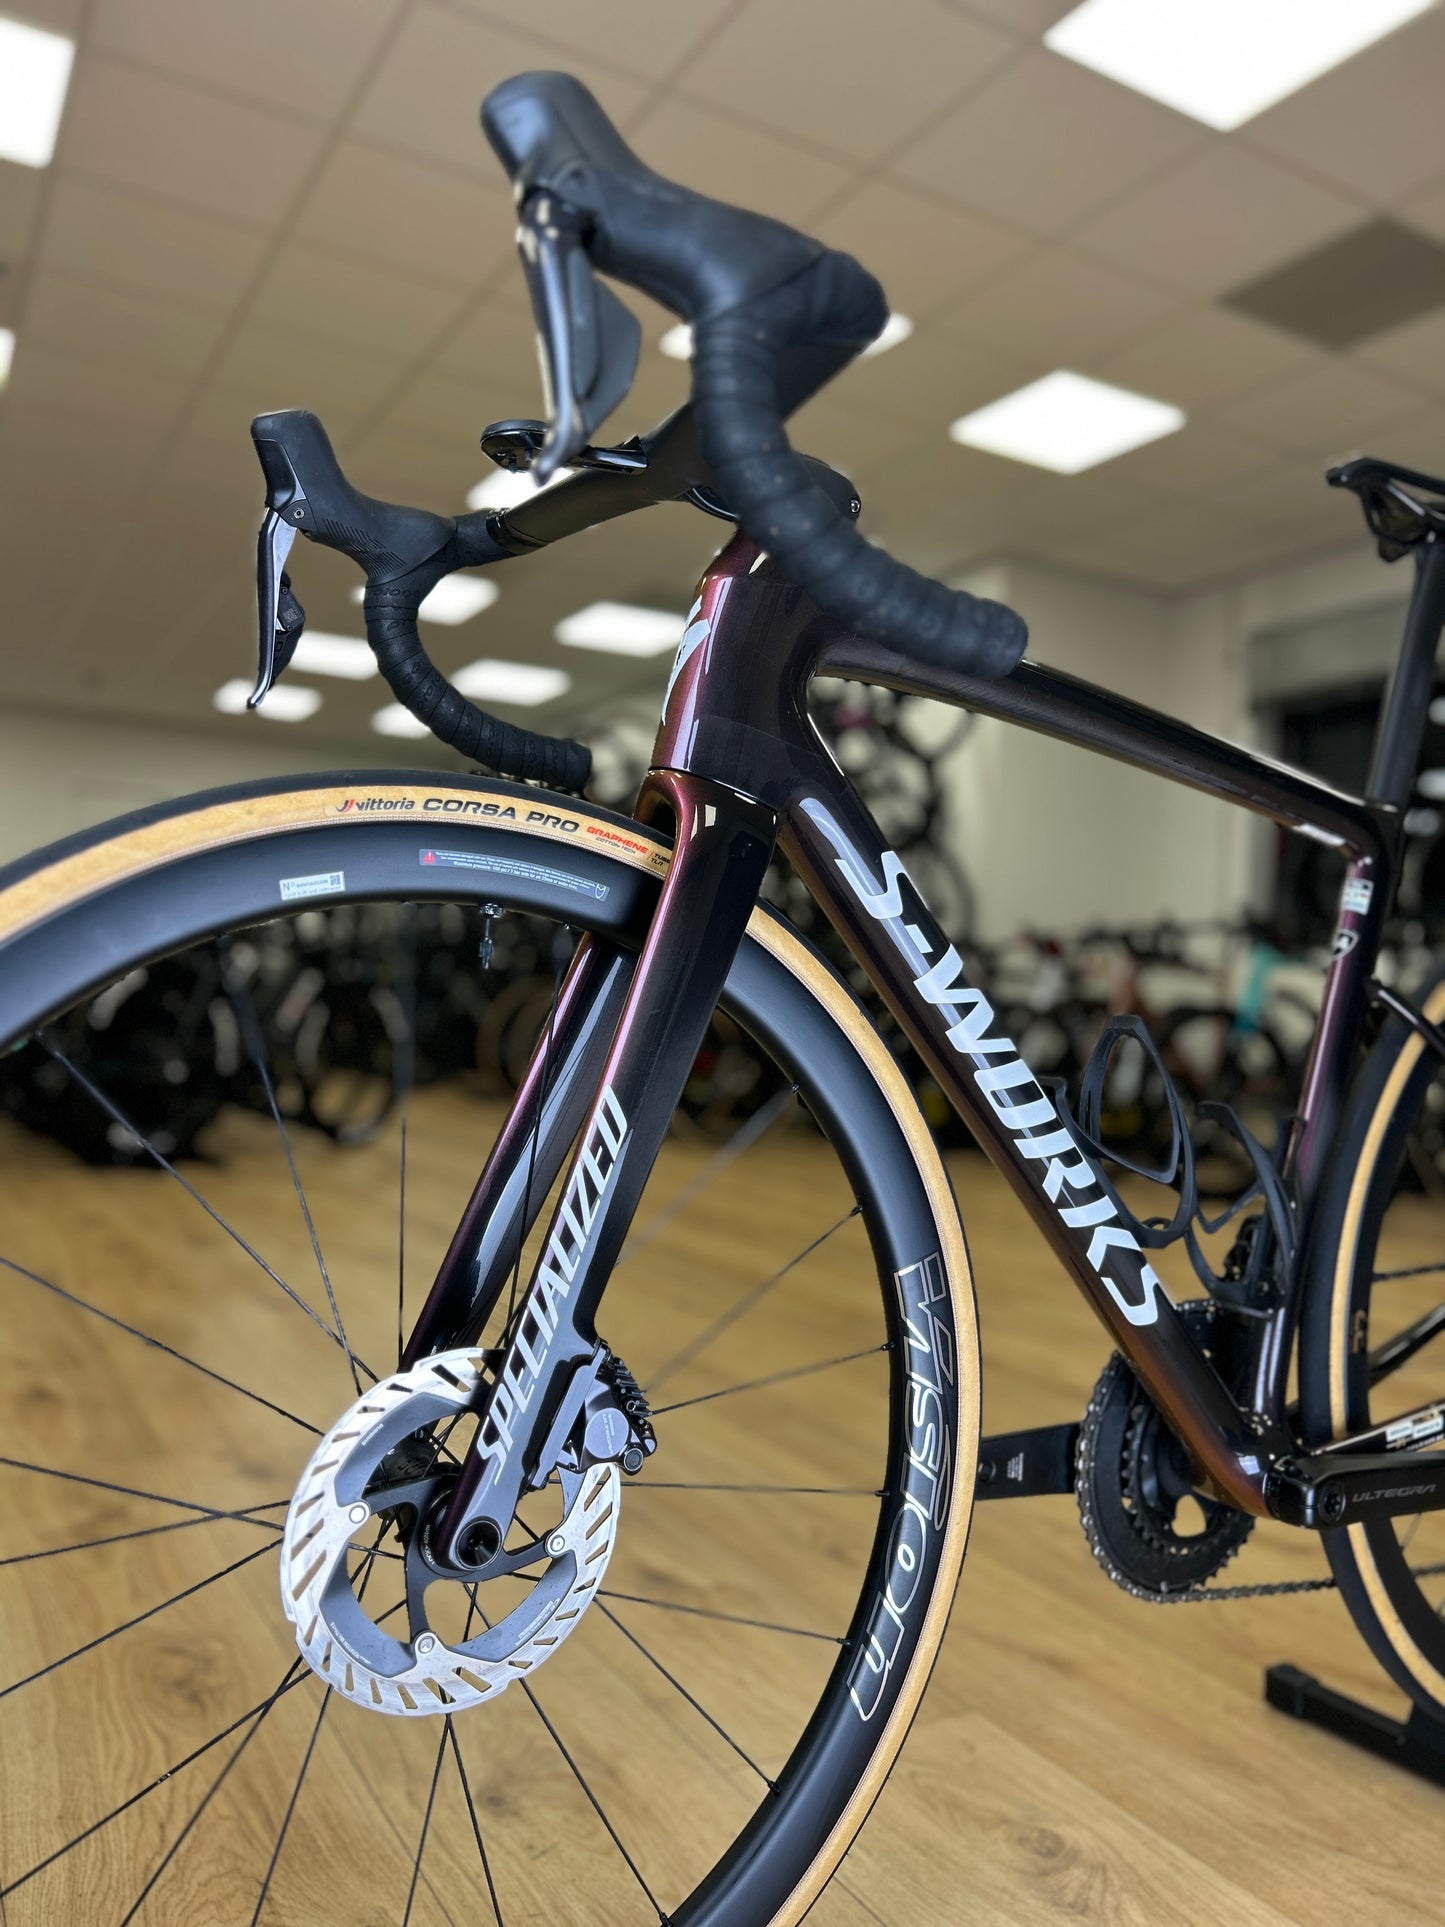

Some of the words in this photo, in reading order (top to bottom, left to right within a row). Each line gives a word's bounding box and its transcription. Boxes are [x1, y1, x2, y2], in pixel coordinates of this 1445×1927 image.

[354, 797, 416, 812] vittoria
[422, 797, 517, 820] CORSA
[525, 810, 580, 834] PRO
[586, 826, 650, 855] GRAPHENE
[833, 850, 1161, 1327] S-WORKS
[476, 1083, 628, 1486] SPECIALIZED
[1352, 1483, 1437, 1503] ULTEGRA
